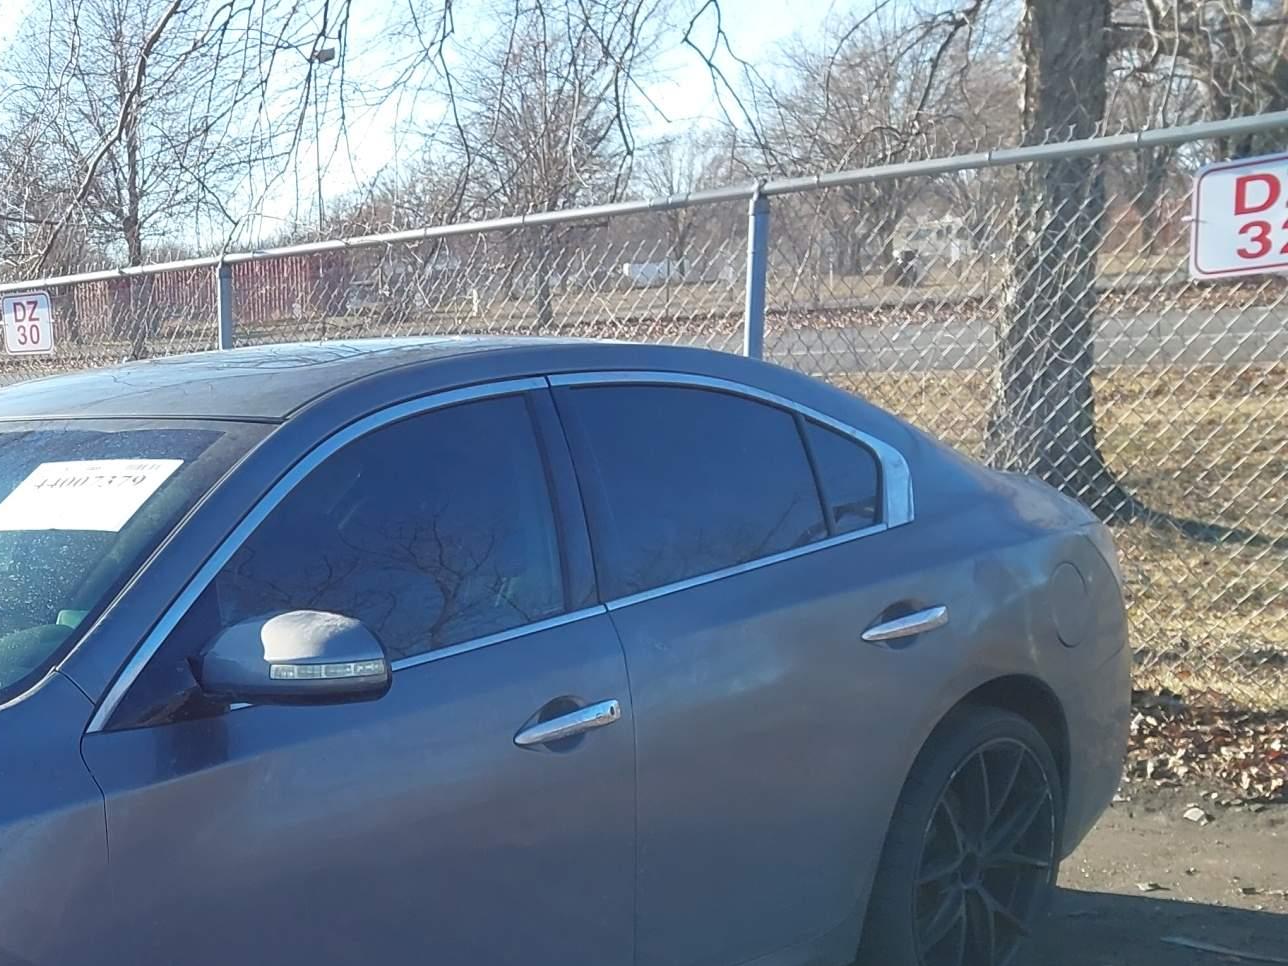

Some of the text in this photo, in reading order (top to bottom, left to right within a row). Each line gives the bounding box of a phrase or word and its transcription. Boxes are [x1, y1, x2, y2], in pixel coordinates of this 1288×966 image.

[1234, 173, 1288, 216] D
[1237, 220, 1288, 259] 3
[12, 300, 40, 323] DZ
[17, 324, 40, 345] 30
